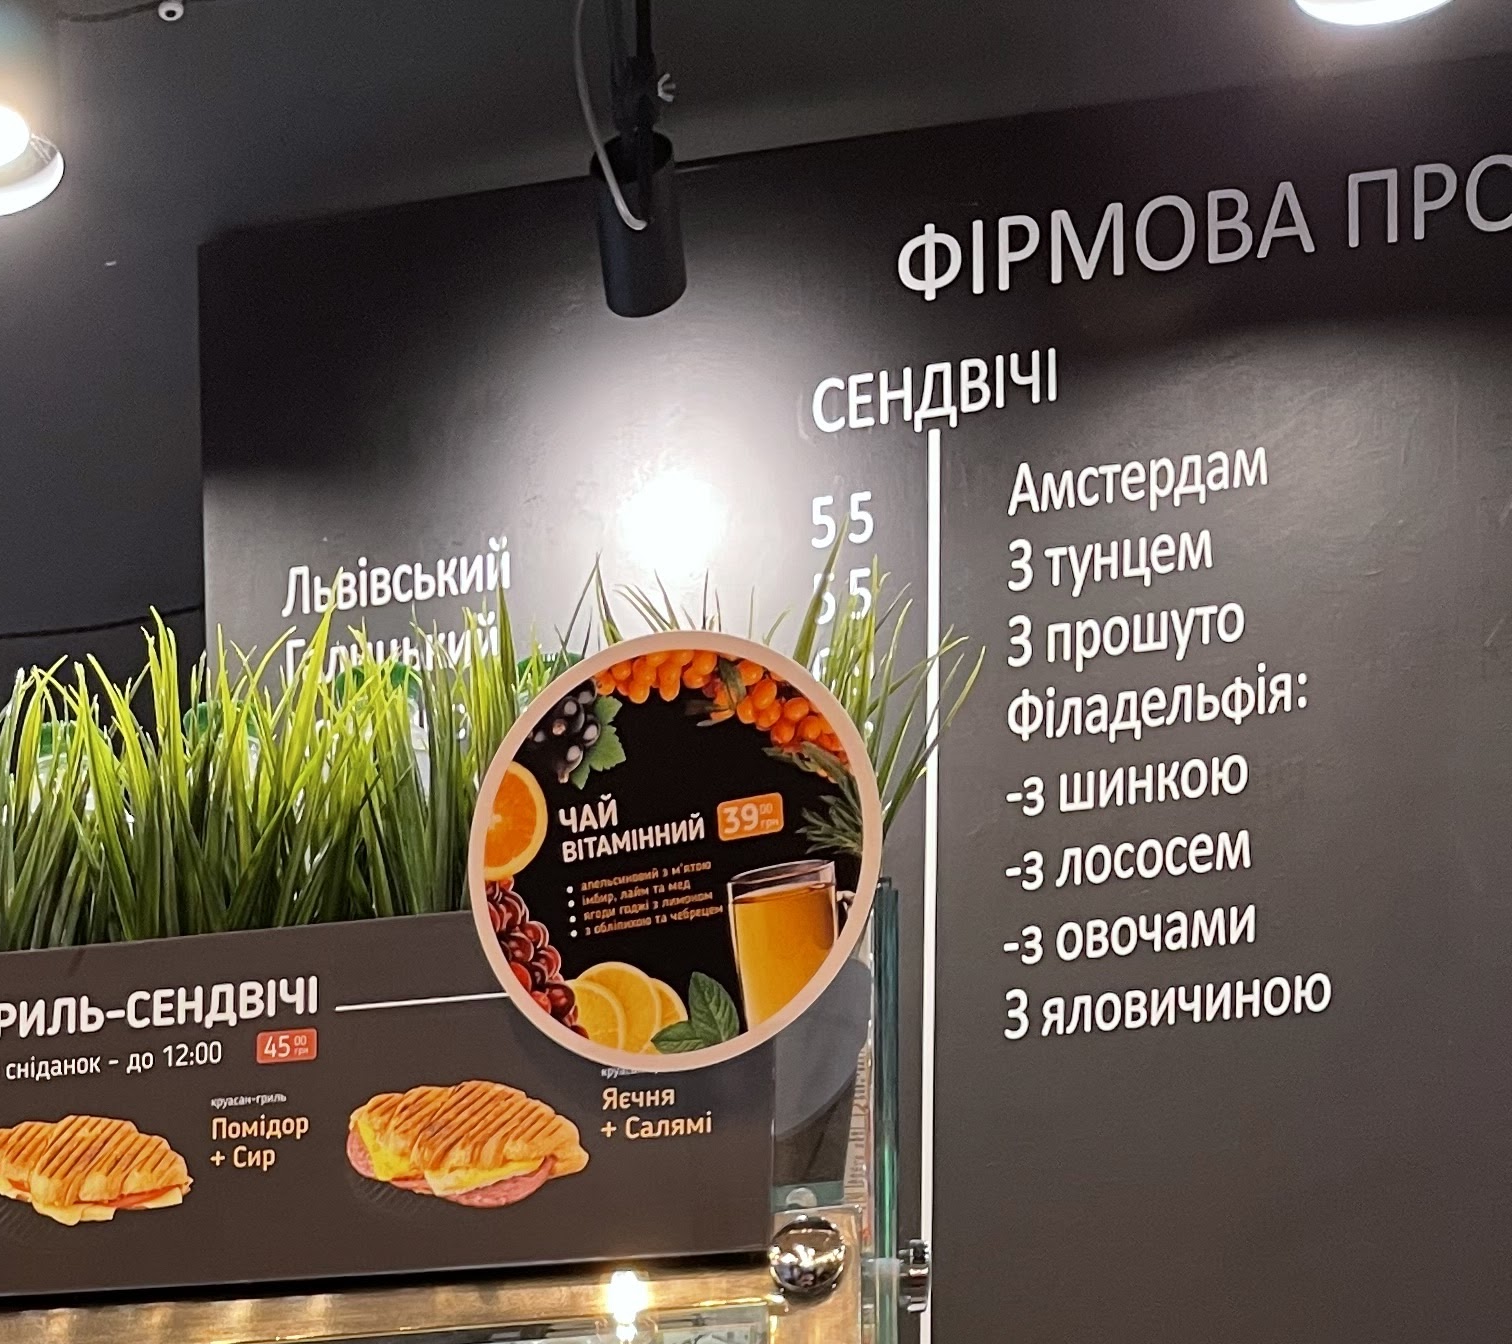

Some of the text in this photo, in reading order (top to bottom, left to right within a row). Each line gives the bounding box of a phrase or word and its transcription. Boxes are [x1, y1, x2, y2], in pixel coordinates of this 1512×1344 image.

[897, 154, 1512, 302] ФІРМОВА ПРО
[811, 346, 1059, 434] СЕНДВІЧІ
[1007, 445, 1269, 517] Амстердам
[280, 490, 875, 617] Львівський 55
[1044, 527, 1213, 598] тунцем
[1045, 601, 1245, 674] прошуто
[1006, 661, 1308, 743] Філадельфія:
[1058, 753, 1249, 814] шинкою
[558, 793, 619, 834] ЧАЙ
[722, 802, 759, 835] 39
[561, 812, 706, 863] ВІТАМІННИЙ
[1055, 828, 1253, 889] лососем
[581, 868, 660, 892] апельсиновий
[620, 885, 649, 900] лайм
[653, 884, 666, 894] та
[668, 879, 692, 891] мед
[655, 914, 668, 924] та
[1055, 903, 1258, 963] овочами
[1041, 970, 1333, 1039] яловичиною
[5, 1054, 102, 1081] сніданок
[126, 1050, 155, 1075] до
[162, 1040, 223, 1068] 12:00
[263, 1034, 308, 1058] 45 00
[211, 1093, 287, 1110] круасан-гриль
[601, 1086, 676, 1112] Яєчня
[210, 1111, 310, 1143] Помідор
[624, 1109, 713, 1139] Салямі
[232, 1144, 276, 1172] Сир
